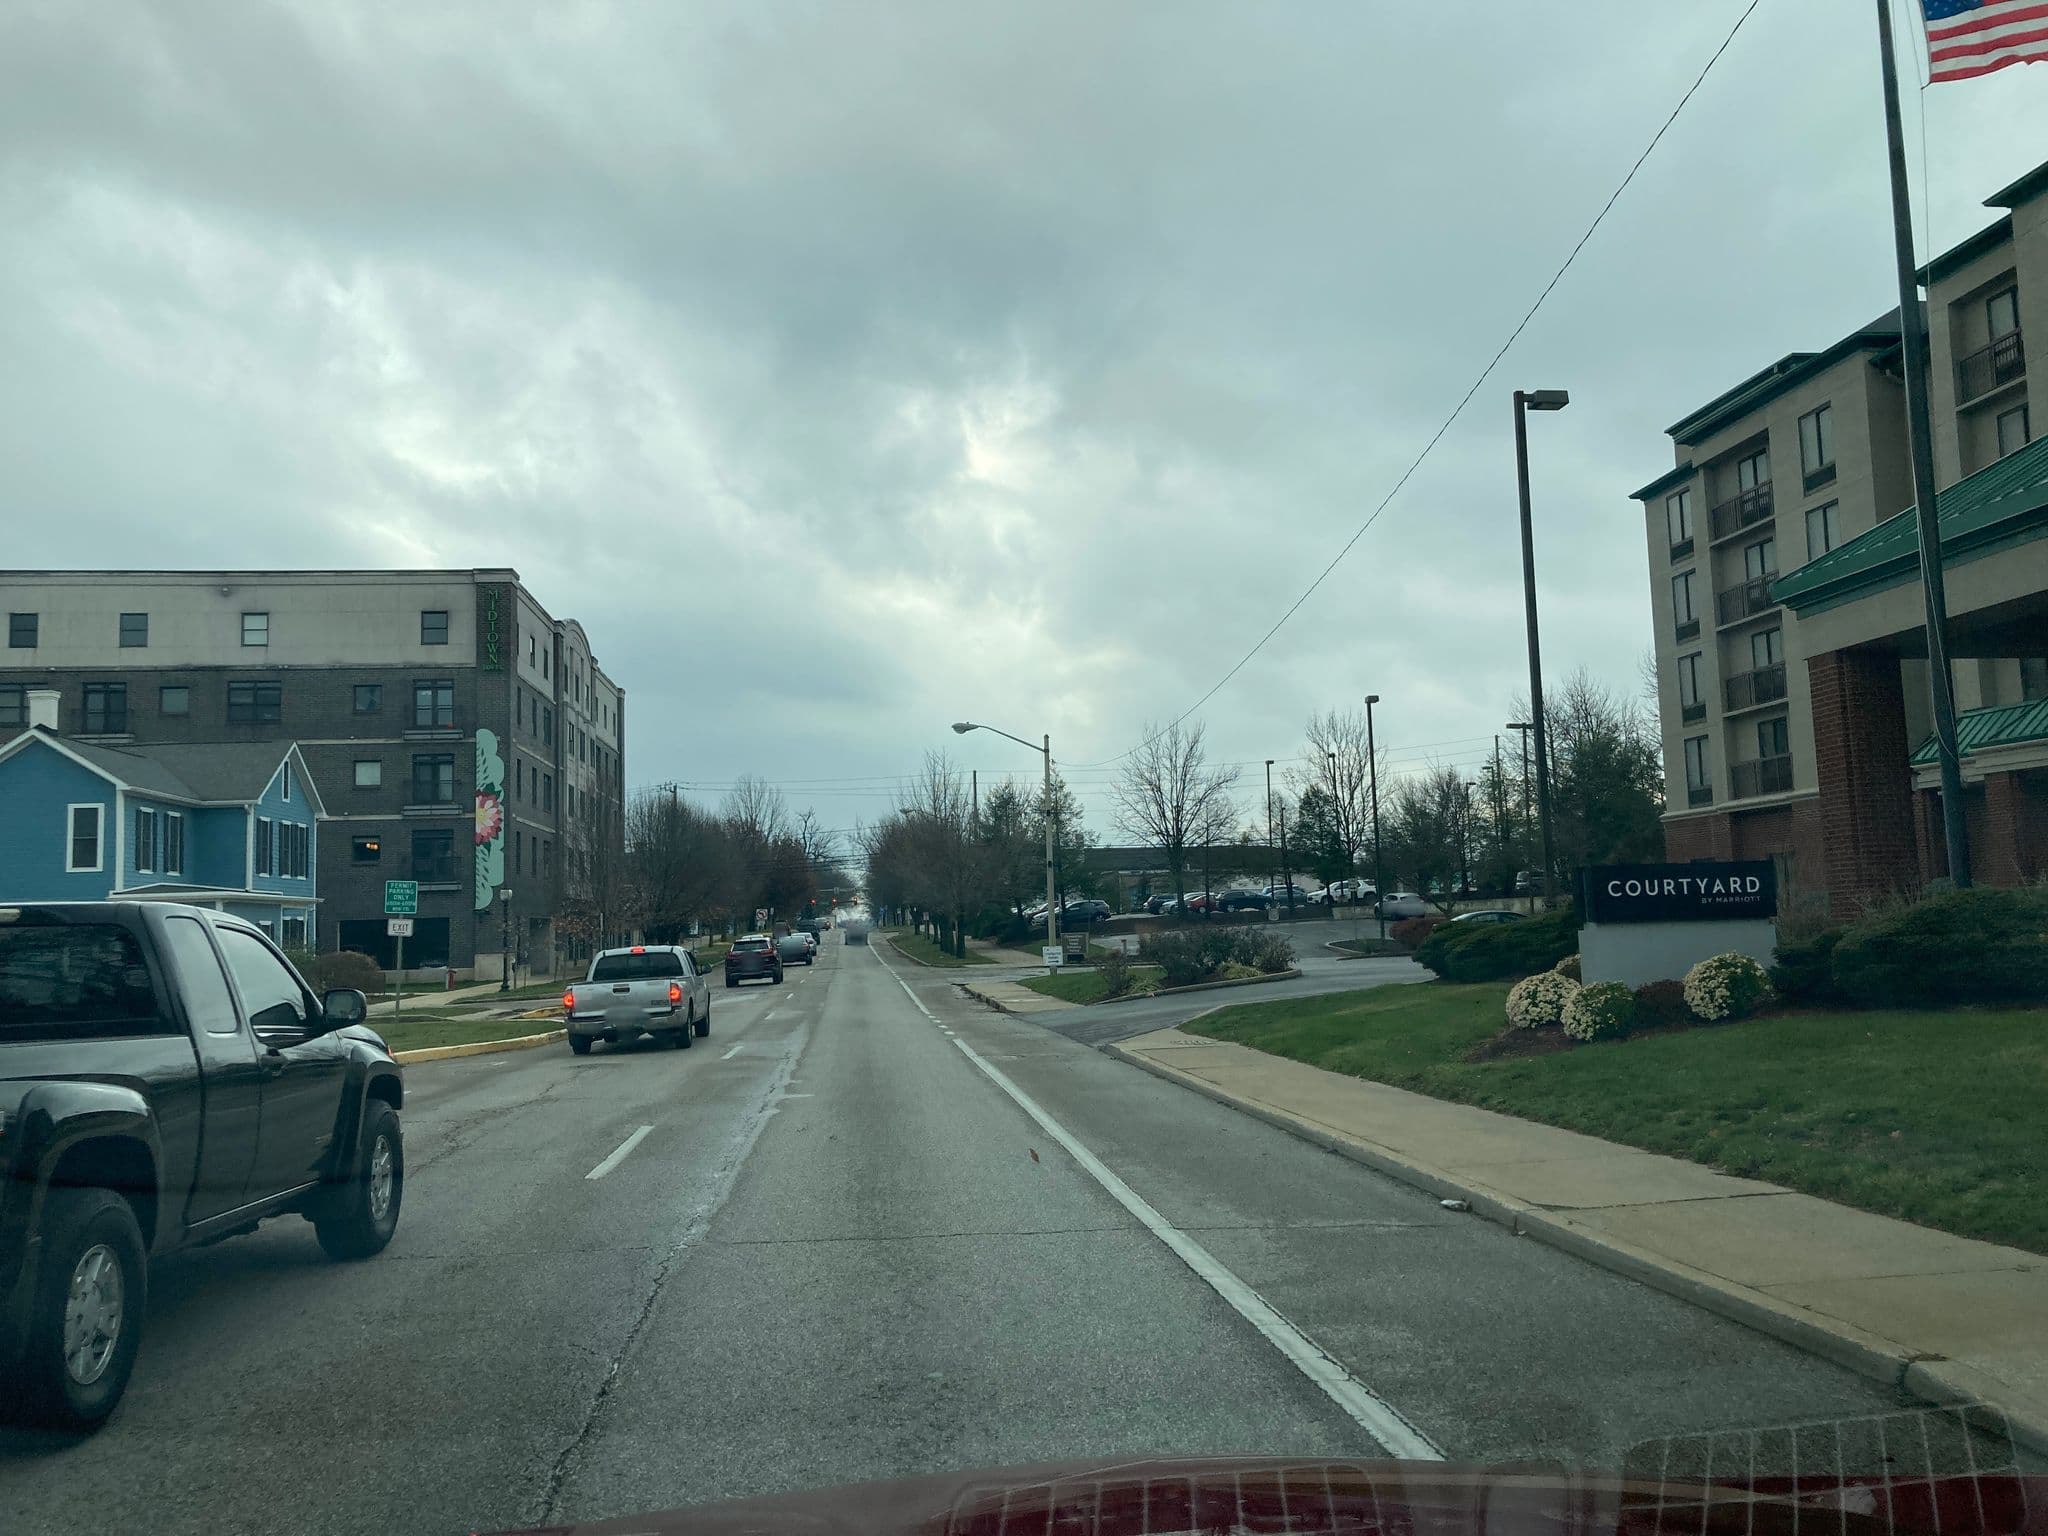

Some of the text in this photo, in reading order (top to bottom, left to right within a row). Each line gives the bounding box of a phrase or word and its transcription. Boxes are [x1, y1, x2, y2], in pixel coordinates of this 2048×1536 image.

[487, 590, 499, 664] MIDTOWN
[1607, 877, 1761, 897] COURTYARD
[1715, 896, 1761, 904] MARRIOTT
[392, 923, 409, 931] EXIT
